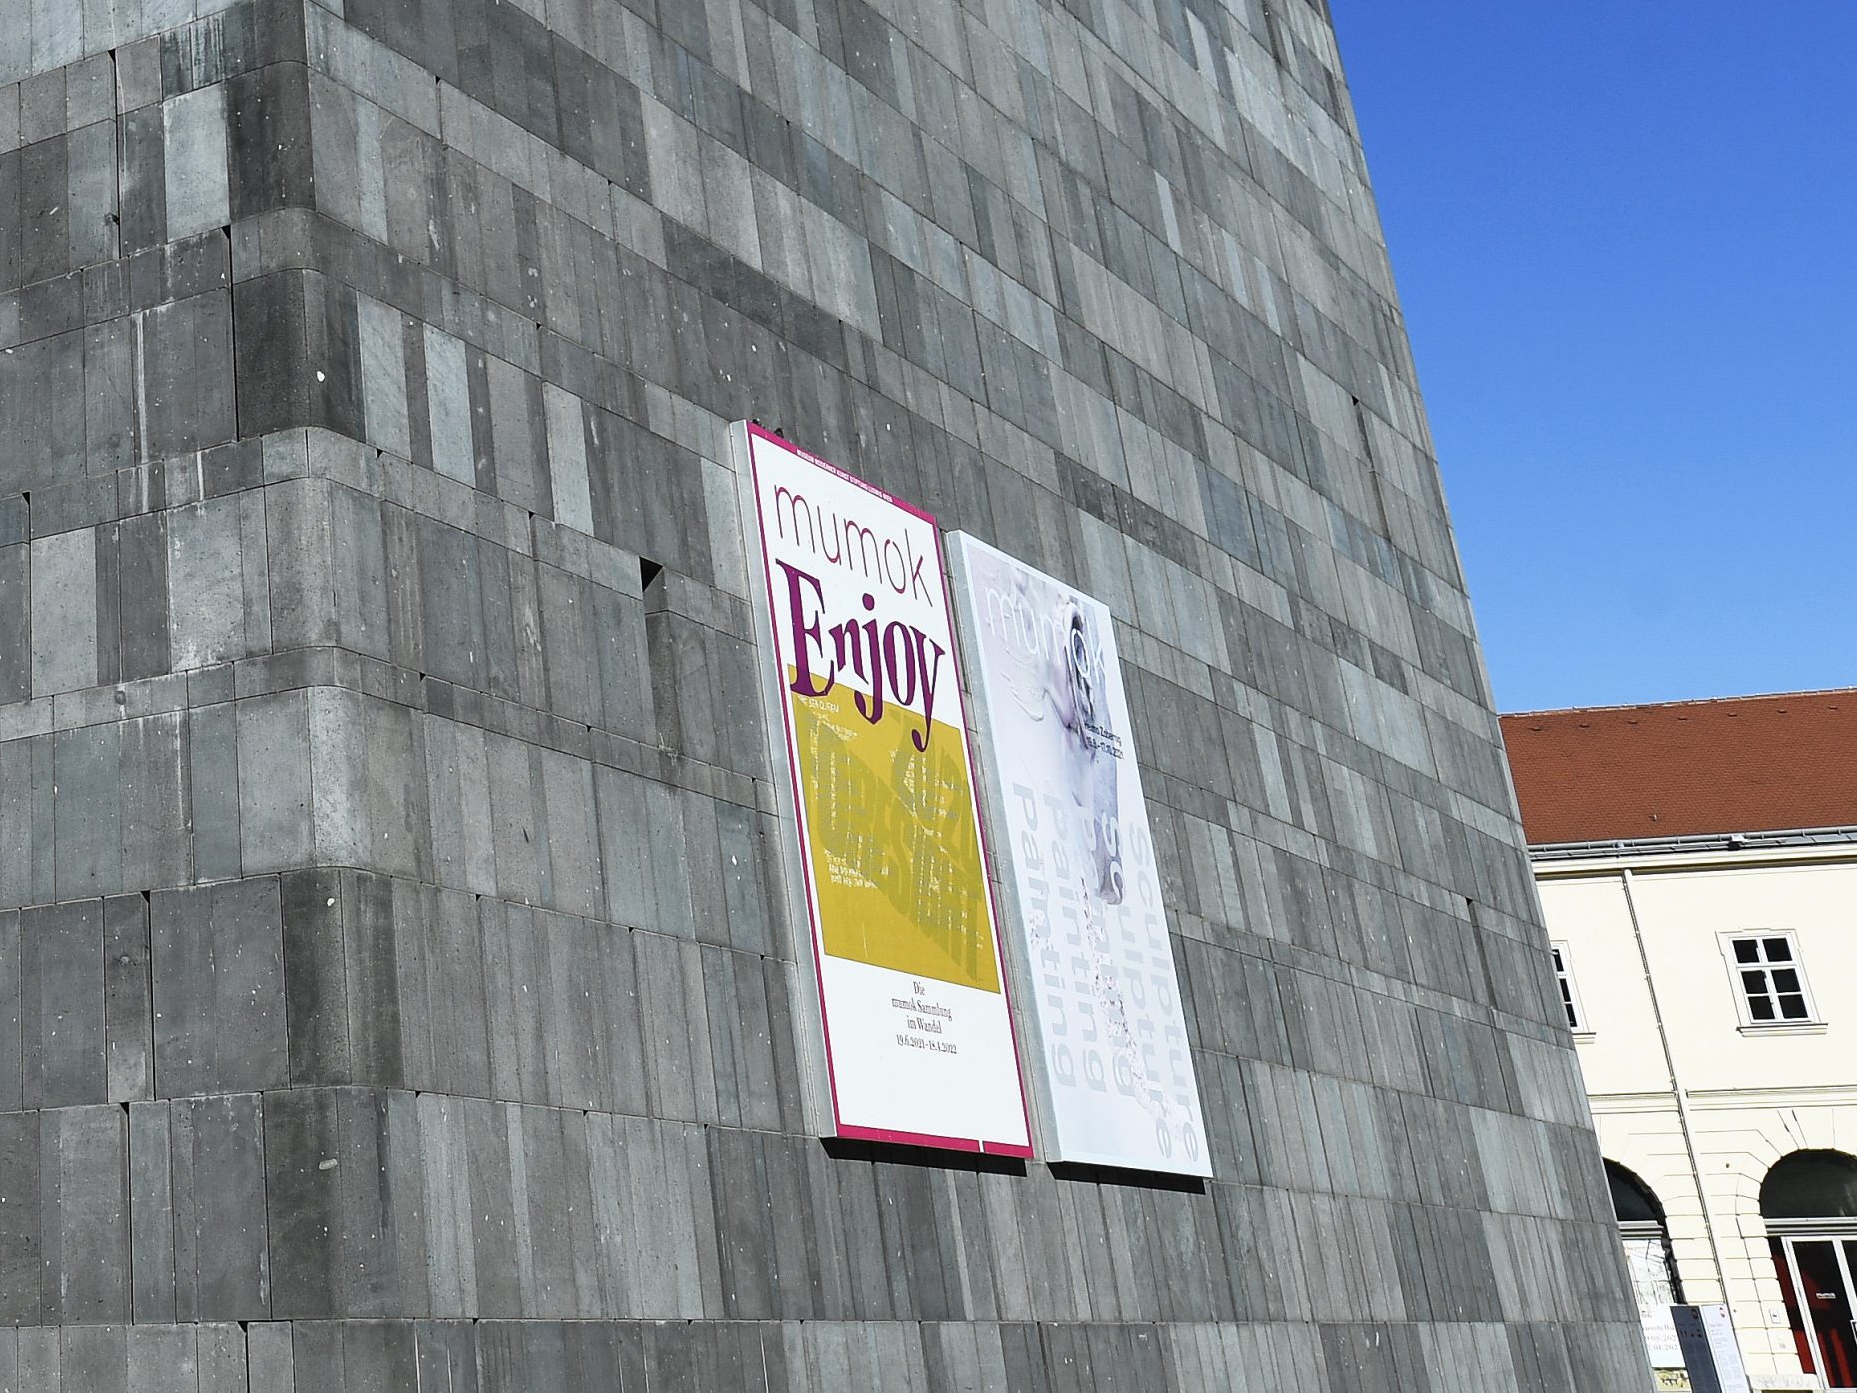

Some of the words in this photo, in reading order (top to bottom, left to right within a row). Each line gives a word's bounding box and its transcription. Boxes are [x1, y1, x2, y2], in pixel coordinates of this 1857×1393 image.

[774, 485, 932, 607] mumok
[776, 558, 945, 752] Enjoy
[986, 587, 1106, 685] mumok
[892, 997, 917, 1012] mumok
[917, 1000, 952, 1021] Sammlung
[913, 981, 926, 996] Die
[907, 1015, 917, 1029] im
[916, 1017, 942, 1034] Wandel
